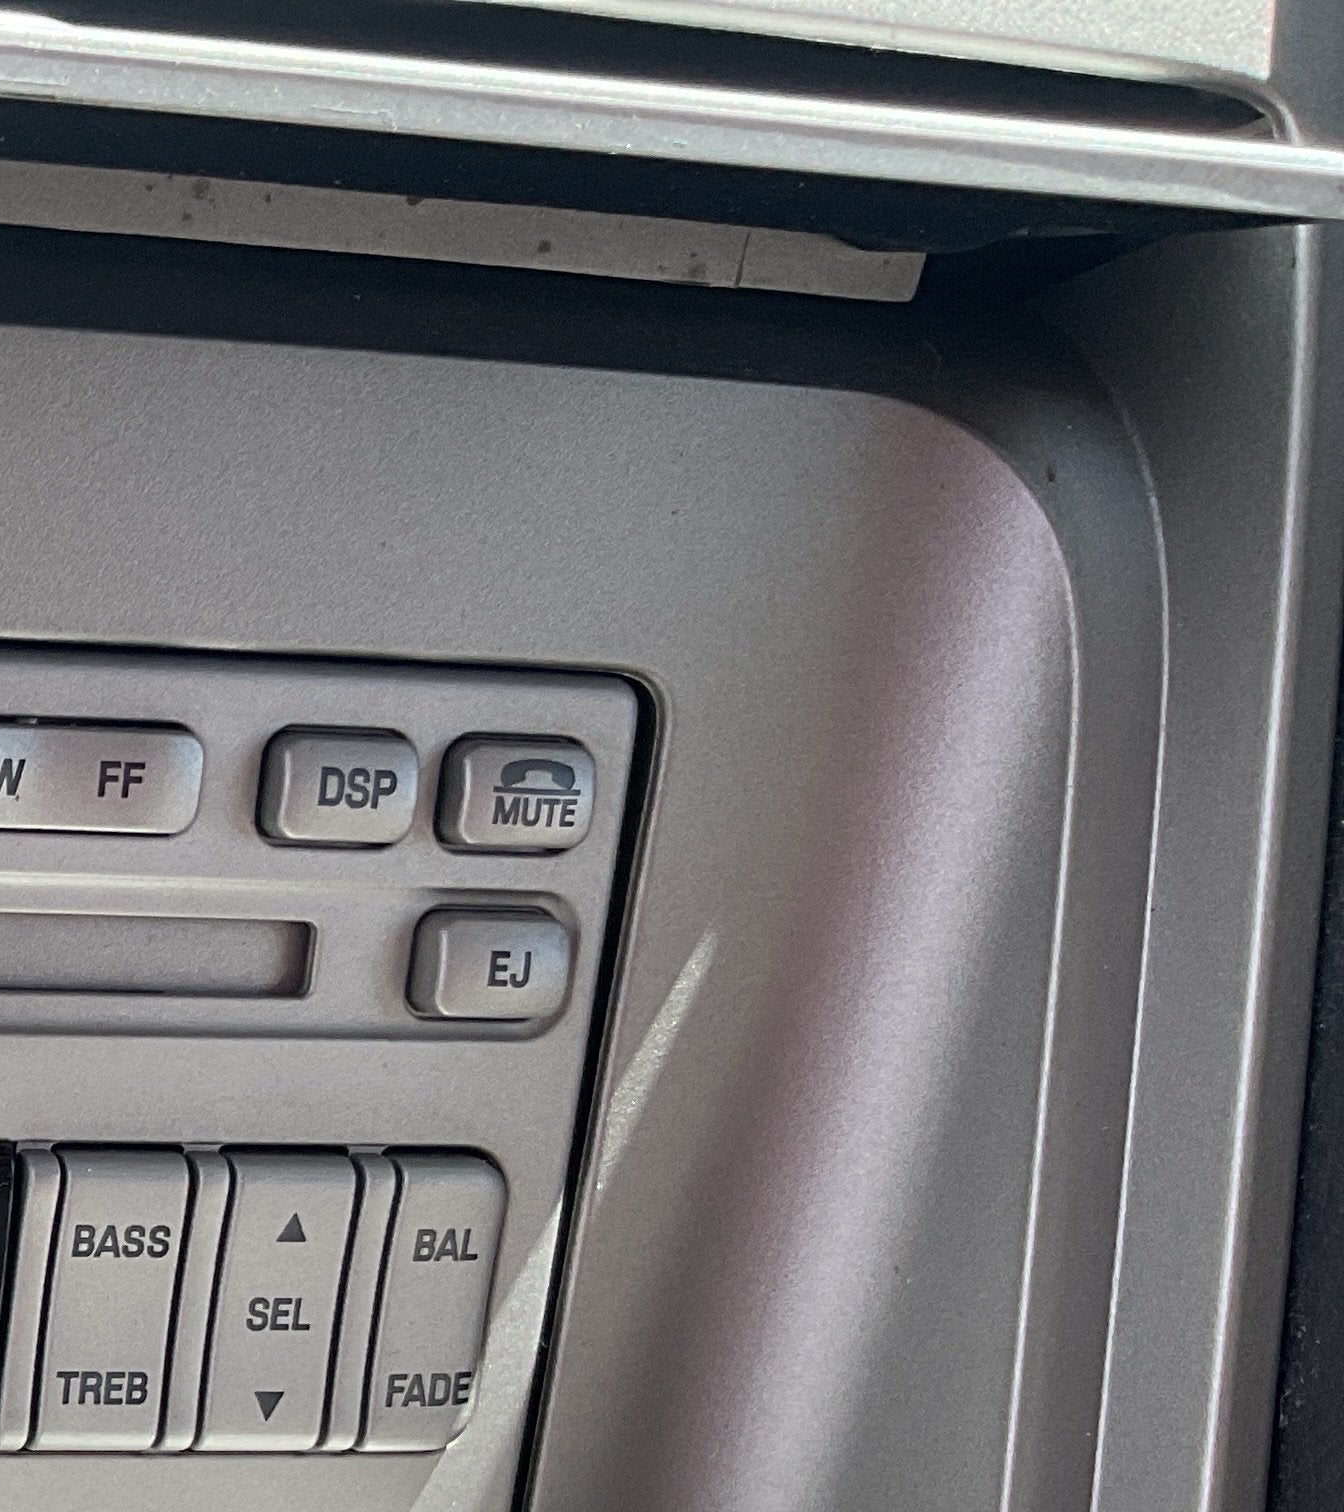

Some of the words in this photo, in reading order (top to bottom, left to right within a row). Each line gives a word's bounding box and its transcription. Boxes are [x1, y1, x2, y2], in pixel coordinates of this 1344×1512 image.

[96, 760, 147, 800] FF
[317, 766, 399, 811] DSP
[491, 794, 577, 829] MUTE
[486, 948, 533, 991] EJ
[70, 1223, 172, 1260] BASS
[411, 1227, 479, 1263] BAL
[245, 1297, 311, 1333] SEL
[56, 1370, 149, 1406] TREB
[384, 1370, 472, 1409] FADE
